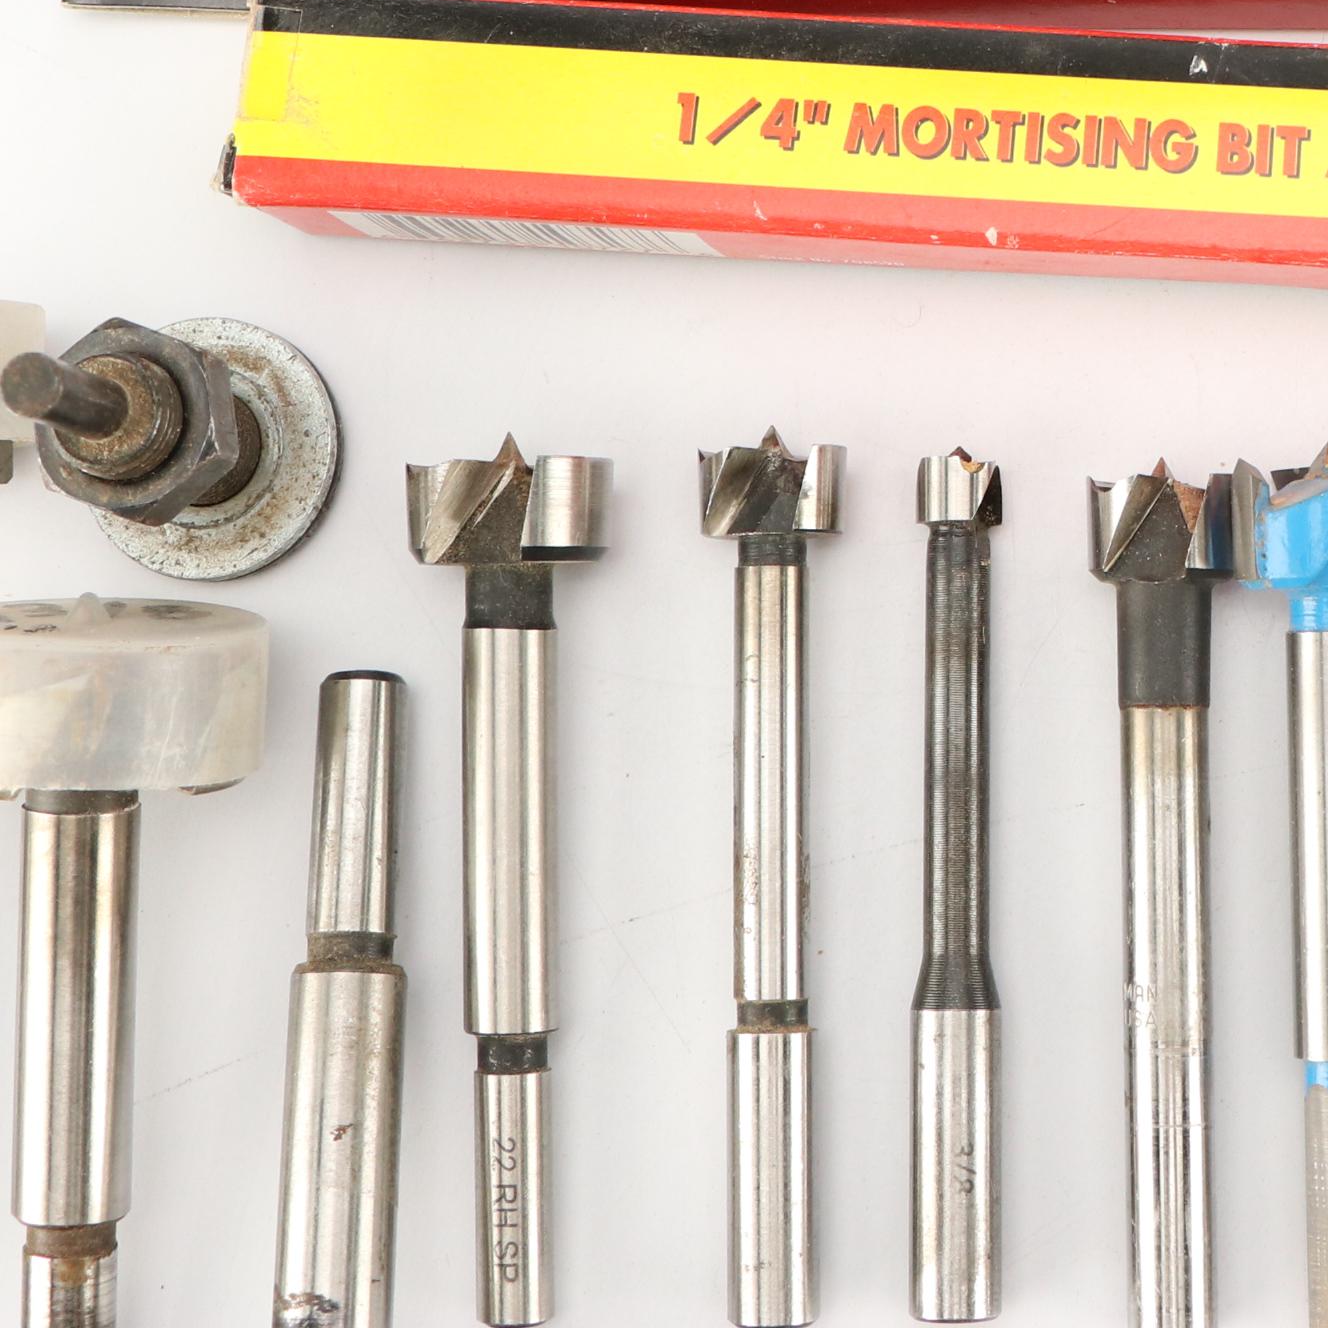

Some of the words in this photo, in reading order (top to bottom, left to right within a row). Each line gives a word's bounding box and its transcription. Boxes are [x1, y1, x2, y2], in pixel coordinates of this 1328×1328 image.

[676, 92, 832, 151] 1/4"
[842, 102, 1199, 174] MORTISING
[1215, 121, 1311, 179] BIT
[491, 1136, 517, 1172] 22
[492, 1183, 518, 1229] RH
[493, 1240, 519, 1283] SP
